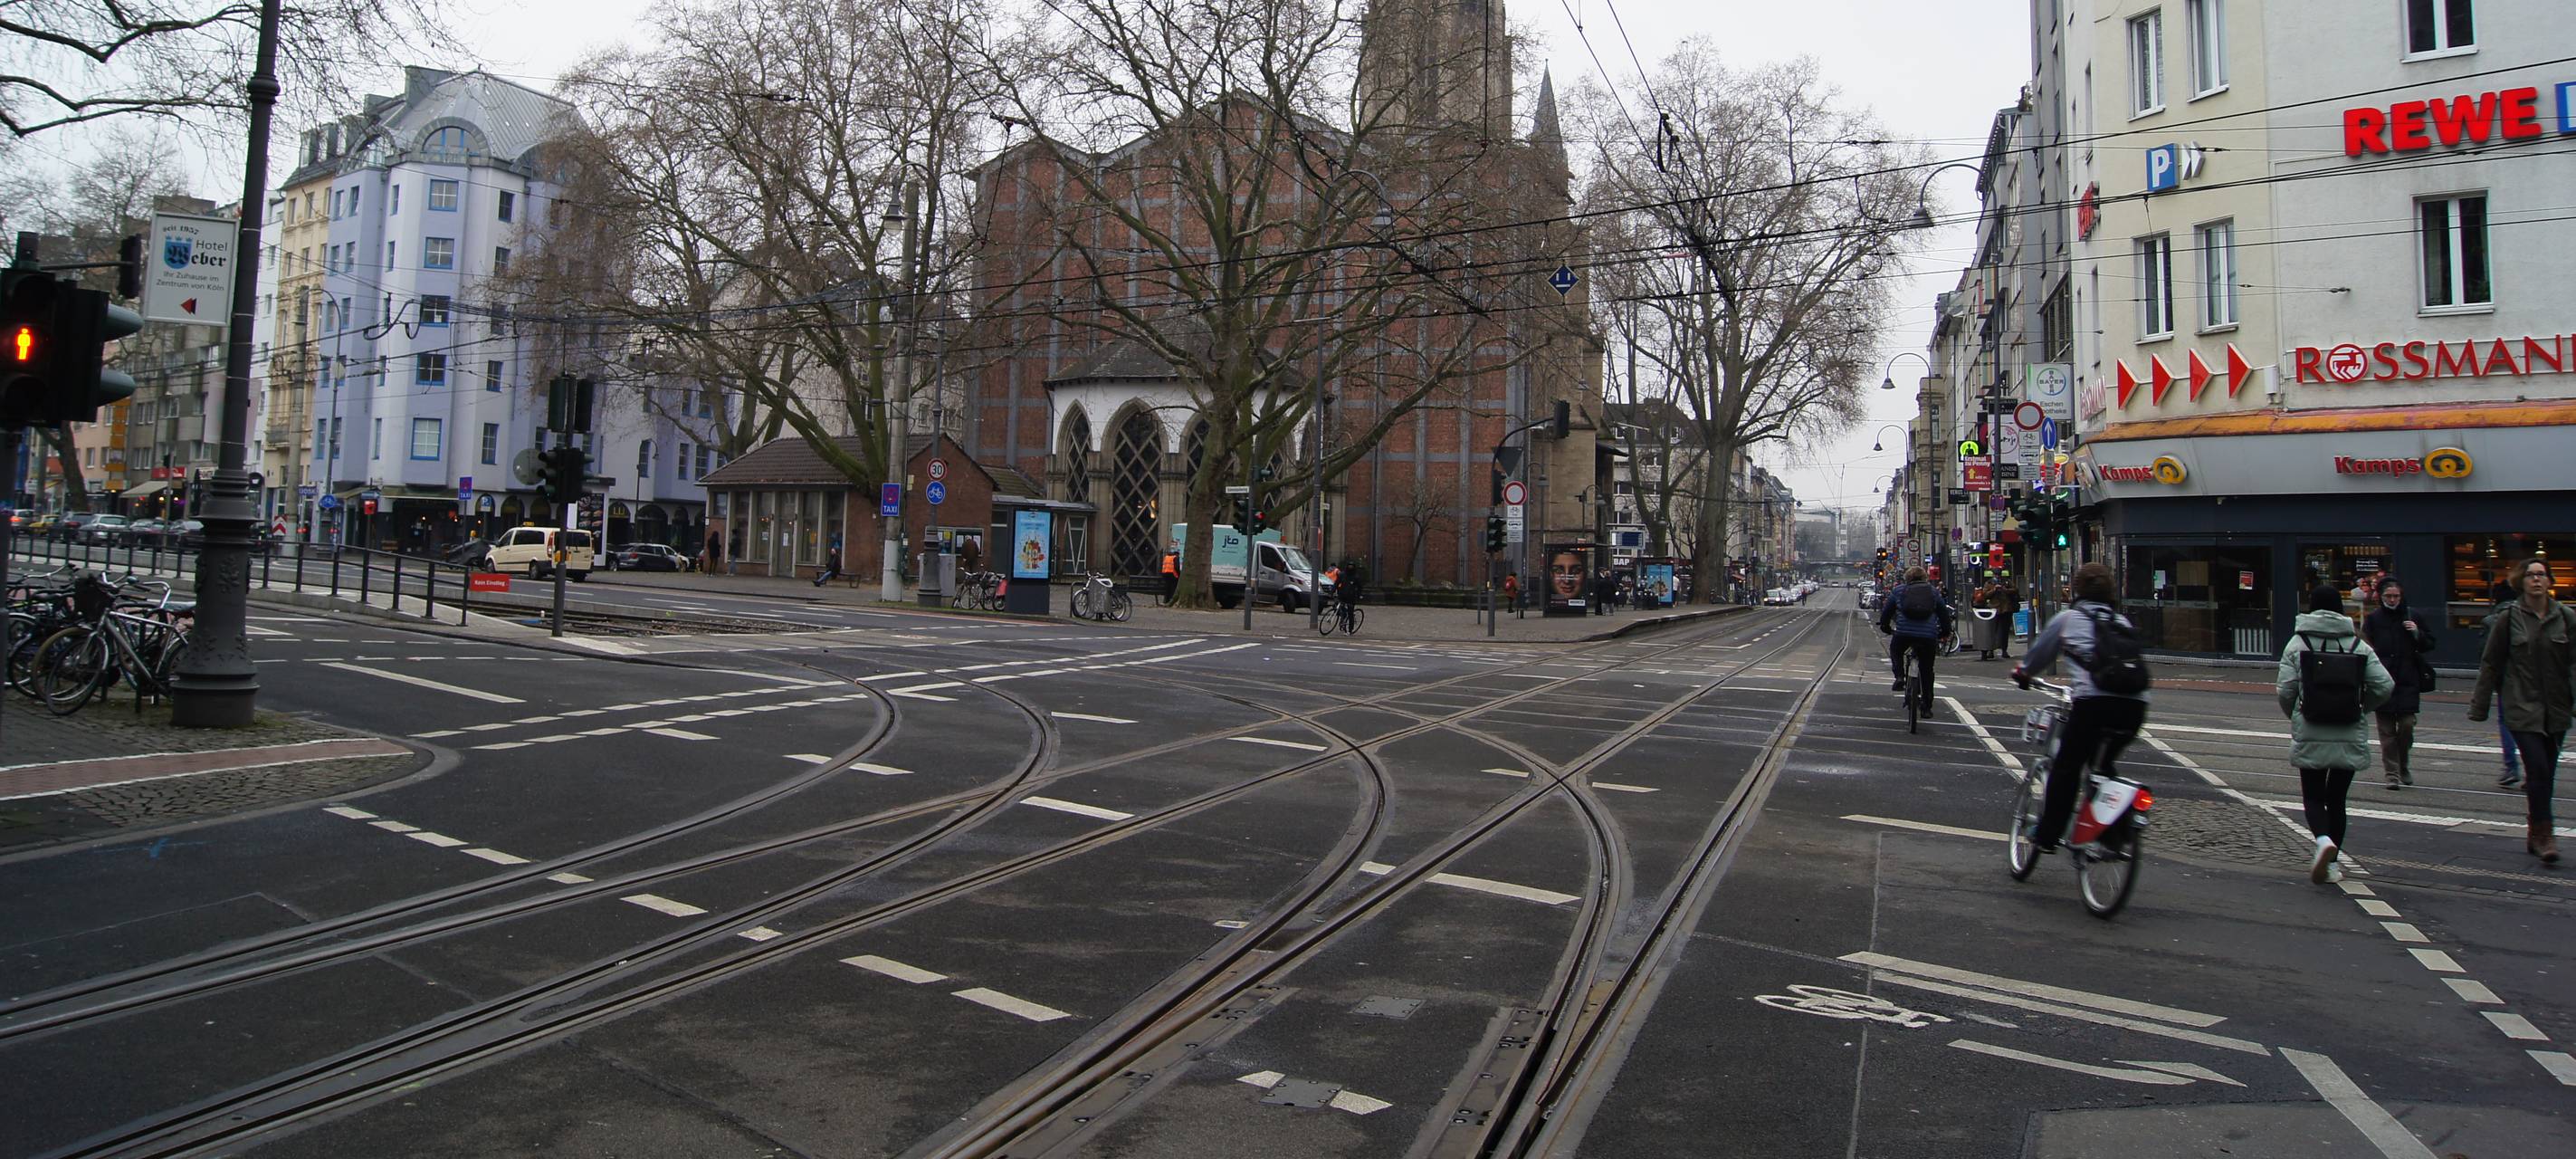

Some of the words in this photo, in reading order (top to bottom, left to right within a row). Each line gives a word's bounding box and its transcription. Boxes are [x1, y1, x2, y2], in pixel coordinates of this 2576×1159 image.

[2343, 87, 2543, 158] REWE
[2151, 148, 2170, 188] P
[196, 240, 228, 252] Hotel
[167, 245, 226, 267] Weber
[157, 279, 188, 288] Zentrum
[207, 283, 225, 291] Köln
[177, 273, 206, 282] Zuhause
[2295, 333, 2576, 384] ROSSMAN
[932, 465, 942, 474] 30
[2098, 464, 2153, 483] Kamps
[2333, 455, 2421, 477] Kamps
[883, 505, 898, 513] TAXI
